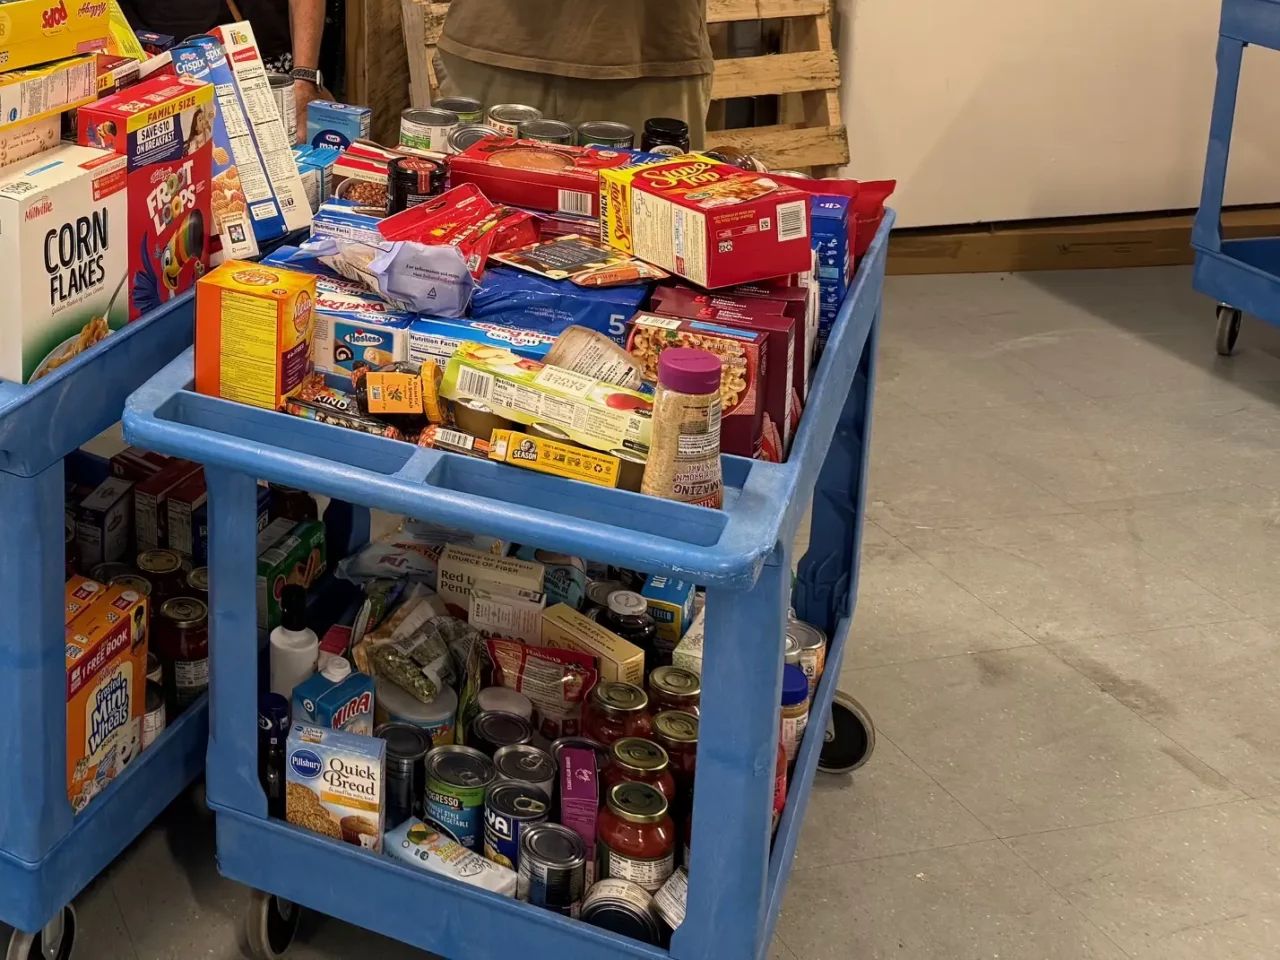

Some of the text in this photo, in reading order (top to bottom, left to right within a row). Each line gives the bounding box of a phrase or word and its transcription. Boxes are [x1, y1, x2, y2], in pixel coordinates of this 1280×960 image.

[41, 0, 68, 29] POPS
[77, 1, 107, 18] Kellogg's
[231, 32, 248, 45] life
[175, 56, 205, 74] Crispix
[147, 96, 196, 123] FAMILY SIZE
[141, 122, 170, 141] SAVE $10
[136, 132, 175, 155] ON BREAKFAST
[642, 161, 712, 188] Stove
[680, 171, 721, 187] Top
[146, 160, 194, 219] FROOT
[25, 201, 53, 222] Millville
[151, 184, 196, 236] LOOPS
[601, 194, 609, 217] PACK
[44, 207, 108, 275] CORN
[50, 255, 105, 306] FLAKES
[608, 314, 625, 336] 5
[347, 332, 381, 344] Hostess
[410, 335, 458, 348] Nutrition Facts
[496, 378, 515, 387] Nutrition
[314, 395, 348, 410] KIND
[513, 450, 538, 461] SEASON
[447, 554, 479, 565] SOURCE
[495, 564, 519, 574] FIBER
[441, 570, 463, 583] Red
[86, 628, 128, 676] FREE BOOK
[97, 672, 122, 702] Frosted
[93, 679, 128, 732] Mini
[332, 692, 372, 730] MIRA
[89, 704, 129, 756] Wheats
[292, 756, 321, 771] Pillsbury
[330, 758, 376, 781] Quick
[323, 770, 376, 796] Bread
